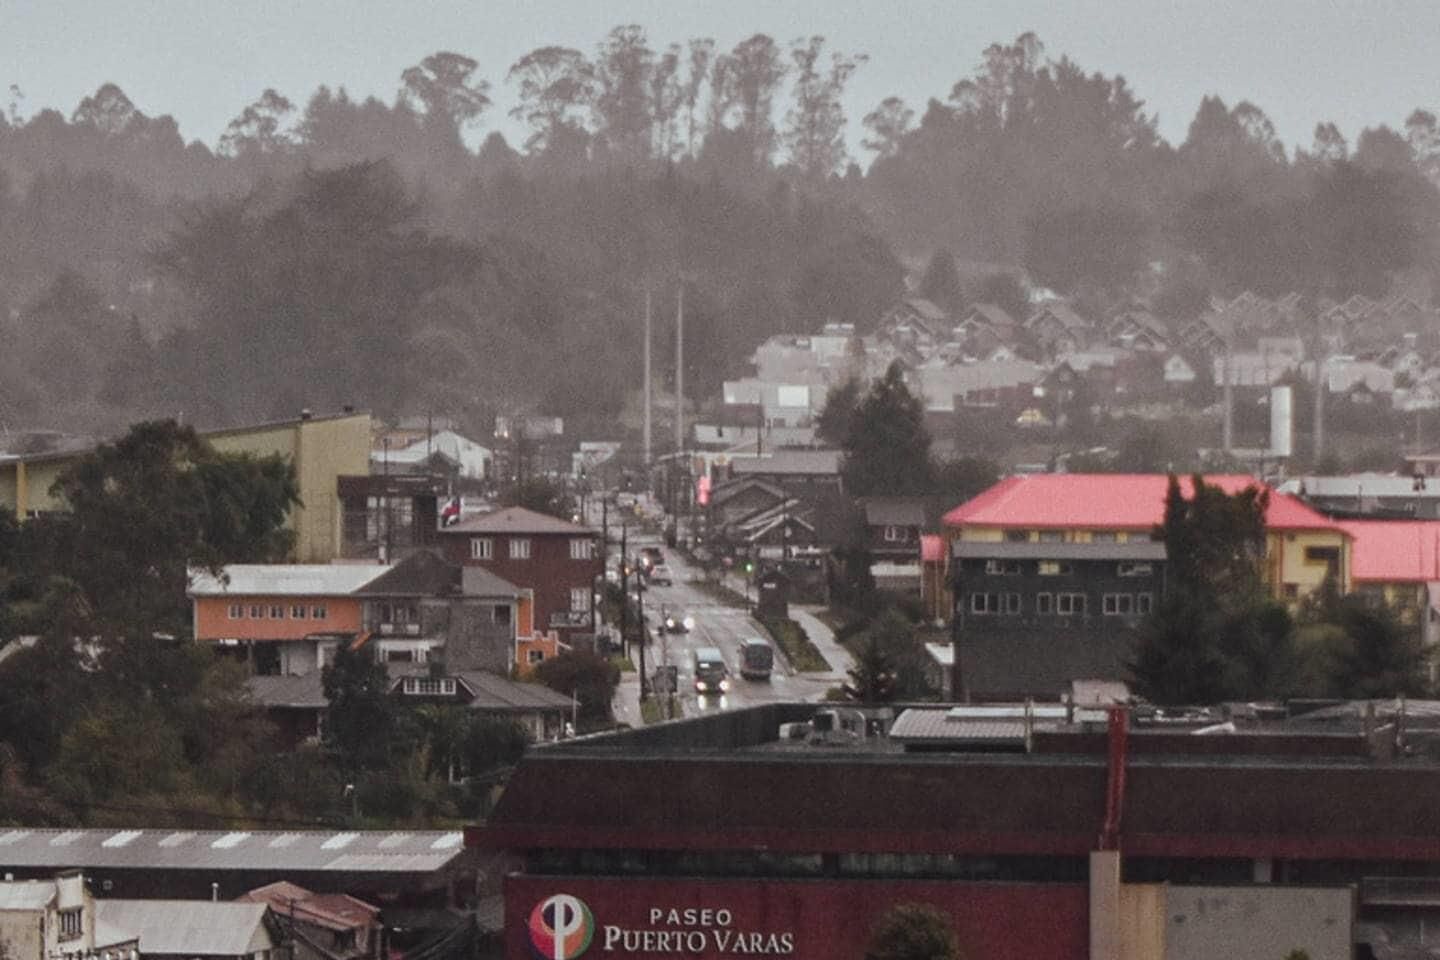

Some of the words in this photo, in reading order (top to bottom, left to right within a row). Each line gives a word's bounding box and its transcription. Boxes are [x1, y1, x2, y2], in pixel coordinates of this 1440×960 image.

[650, 907, 733, 926] PASEO
[604, 926, 707, 953] PUERTO
[713, 930, 795, 954] VARAS
